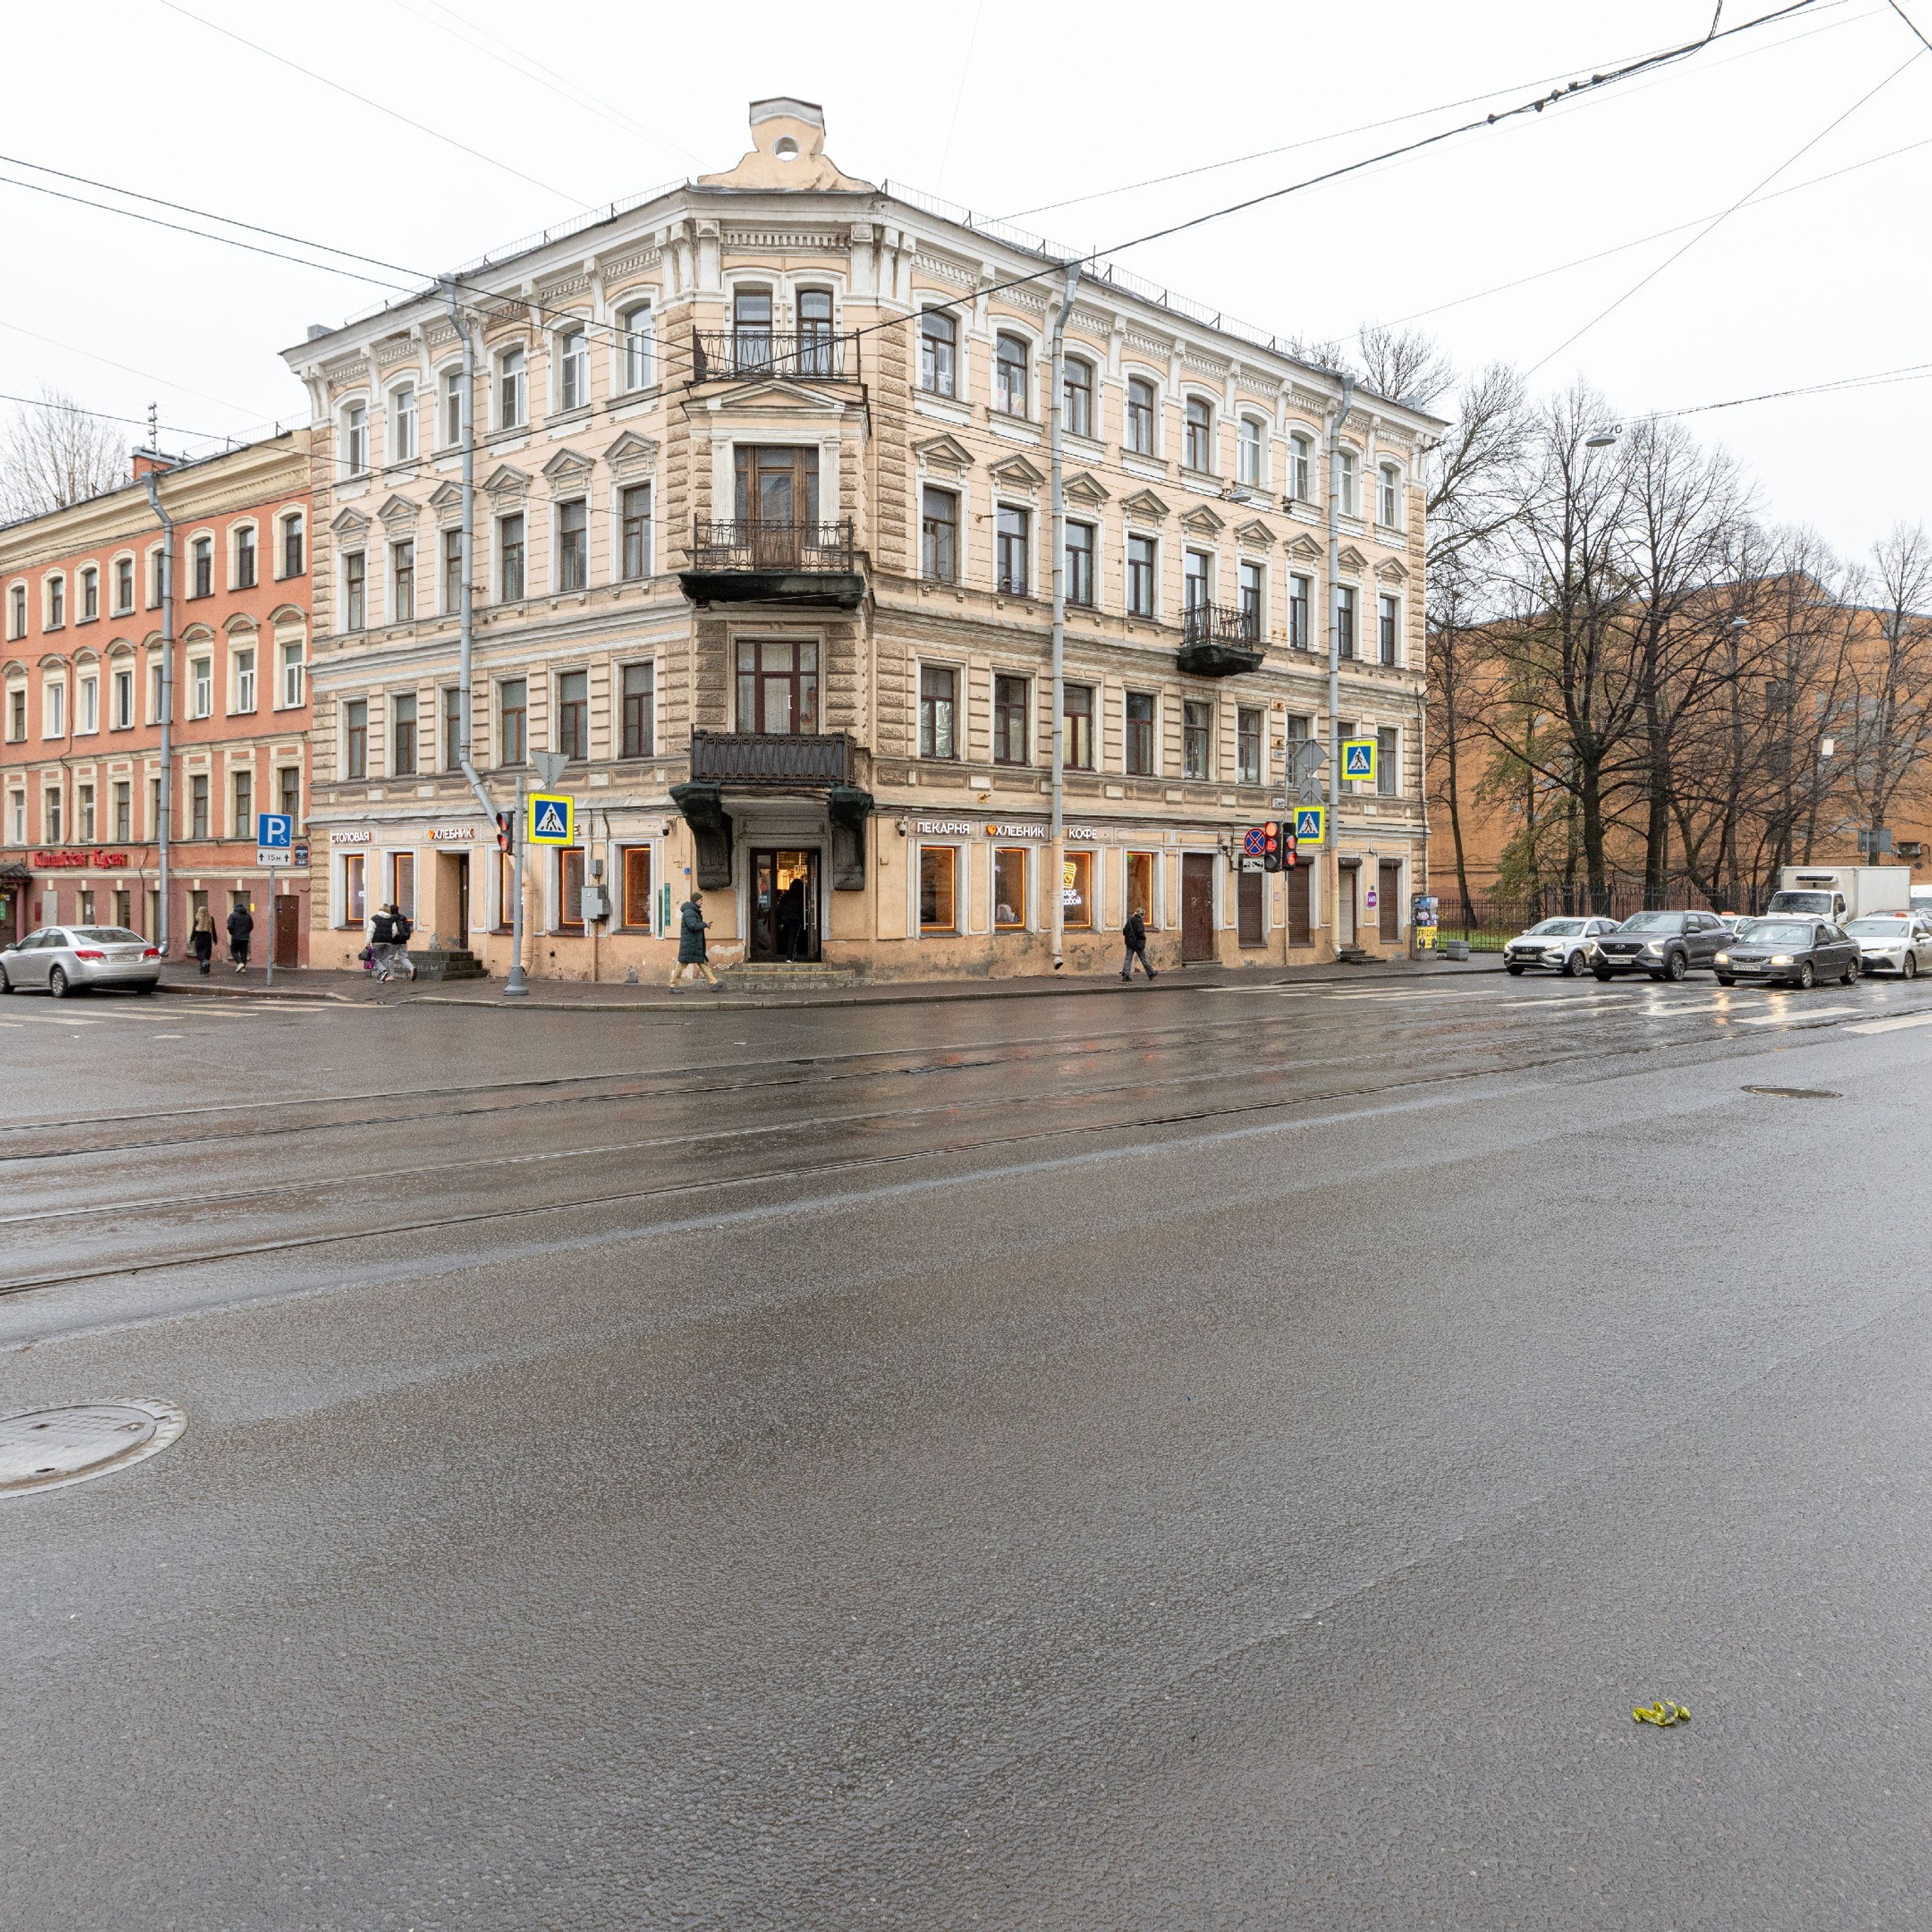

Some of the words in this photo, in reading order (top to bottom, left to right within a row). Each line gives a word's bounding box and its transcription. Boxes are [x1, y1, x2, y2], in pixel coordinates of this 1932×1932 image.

[267, 817, 286, 844] P
[433, 828, 472, 839] ХЛЕБНИК
[917, 822, 970, 834] ПЕКАРНЯ
[995, 825, 1044, 838] ХЛЕБНИК
[1069, 828, 1097, 839] КОФЕ
[330, 832, 370, 843] СТОЛОВАЯ
